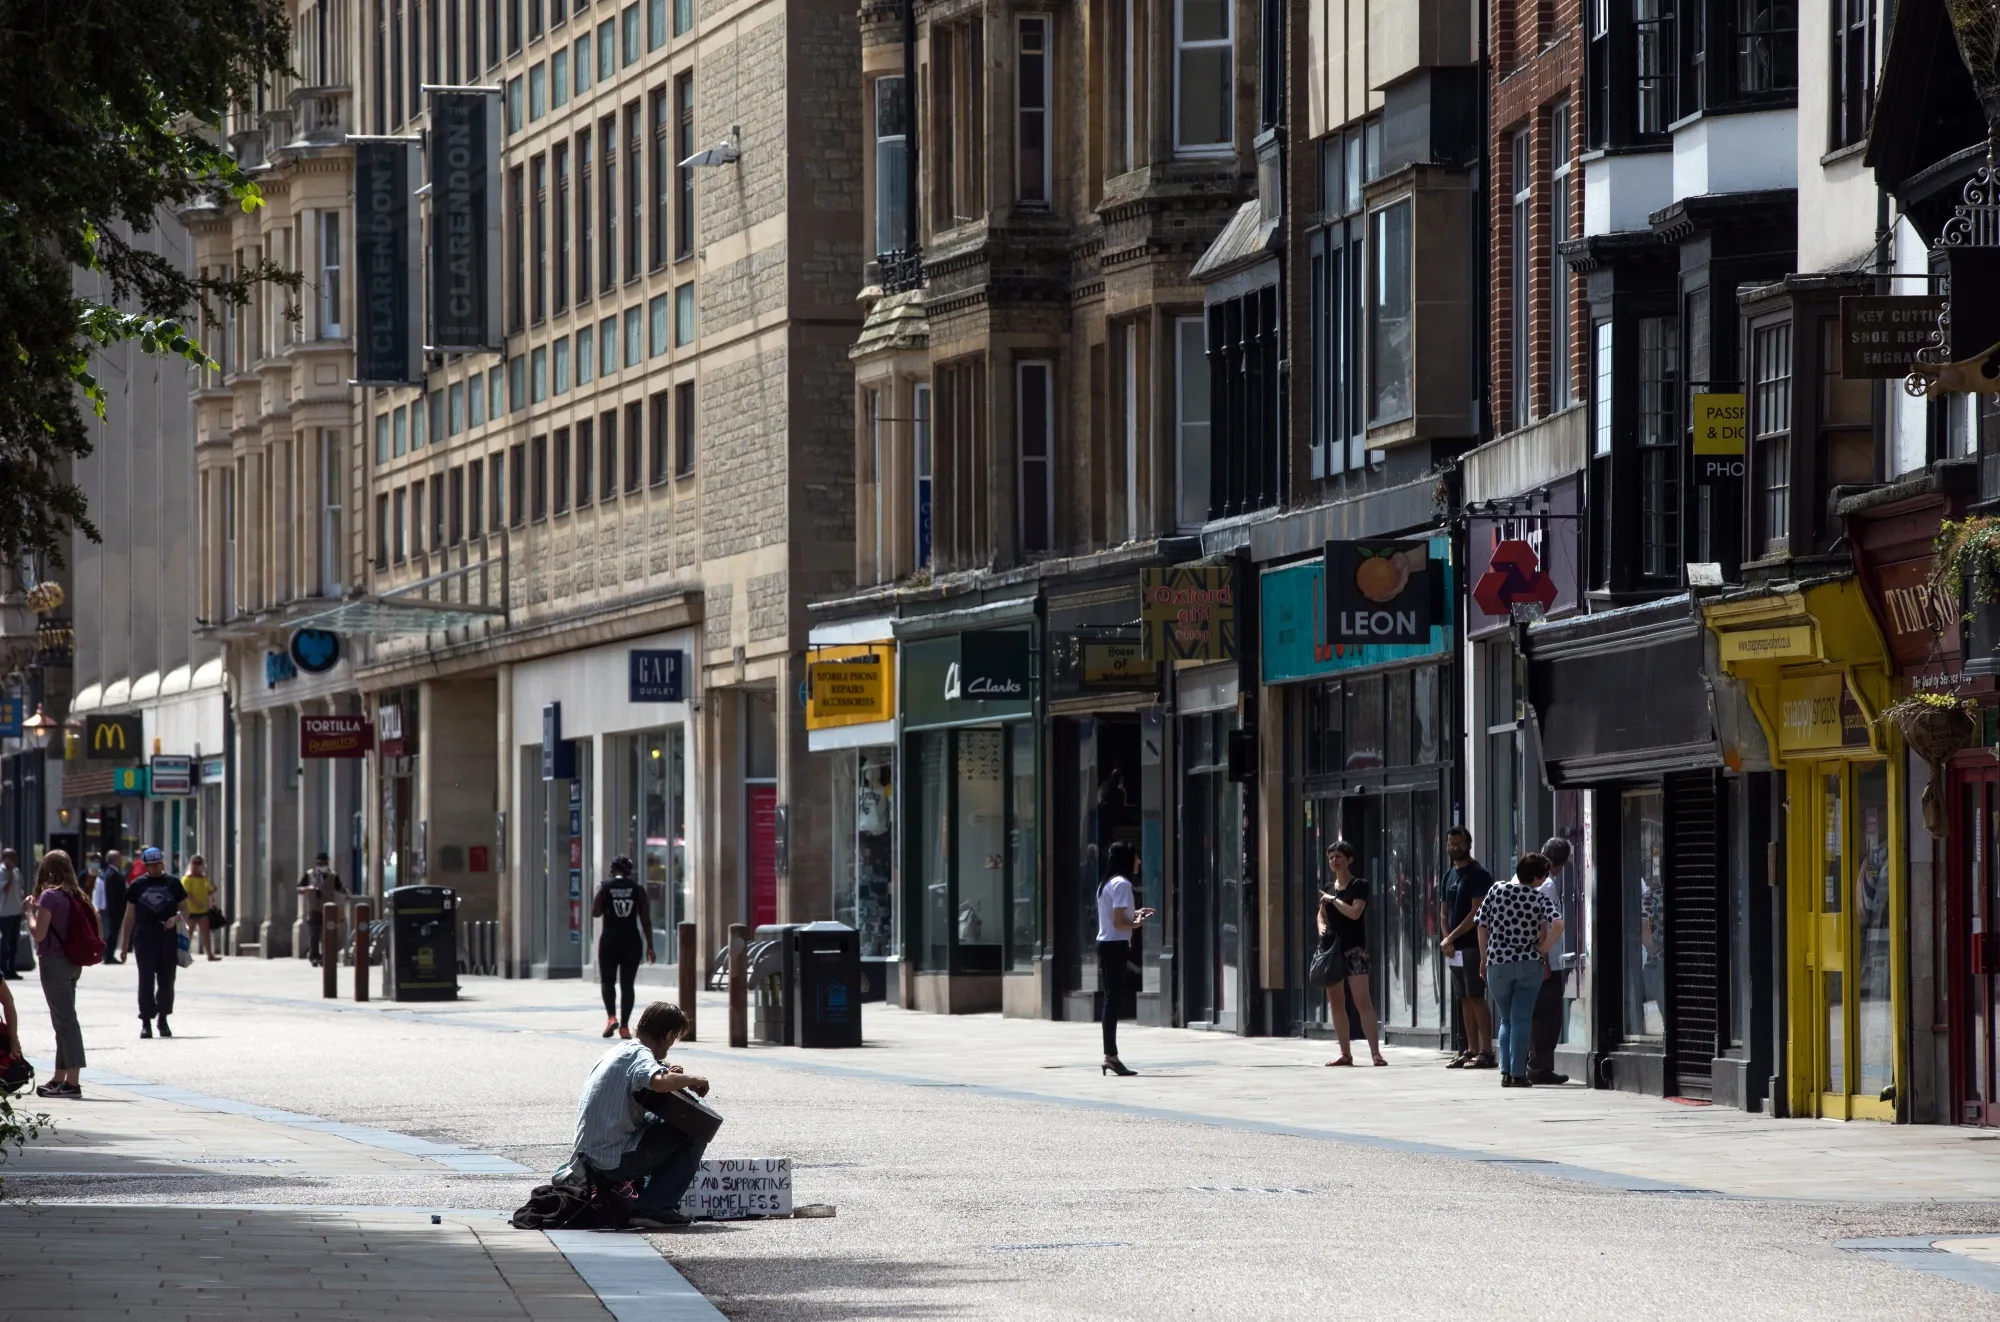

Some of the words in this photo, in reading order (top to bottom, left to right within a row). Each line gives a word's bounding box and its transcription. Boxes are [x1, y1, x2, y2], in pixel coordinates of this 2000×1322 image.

[448, 106, 470, 116] THE
[448, 123, 472, 318] CLARENDON
[371, 170, 394, 353] CLARENDON
[1857, 310, 1885, 322] KEY
[1851, 331, 1889, 343] SHOE
[1707, 426, 1718, 440] &
[1155, 584, 1230, 604] Oxford
[1177, 604, 1213, 627] gift
[1340, 610, 1416, 636] LEON
[1174, 628, 1212, 643] shop
[639, 656, 675, 684] GAP
[831, 684, 865, 694] REPAIRS
[967, 676, 1022, 693] Clarks
[305, 719, 361, 732] TORTILLA
[719, 1160, 745, 1173] YOU
[749, 1160, 760, 1173] 4
[766, 1159, 788, 1173] UR
[700, 1176, 719, 1190] AND
[722, 1176, 791, 1191] SUPPORTING
[701, 1194, 781, 1210] HOMELESS
[707, 1208, 728, 1217] KEEP
